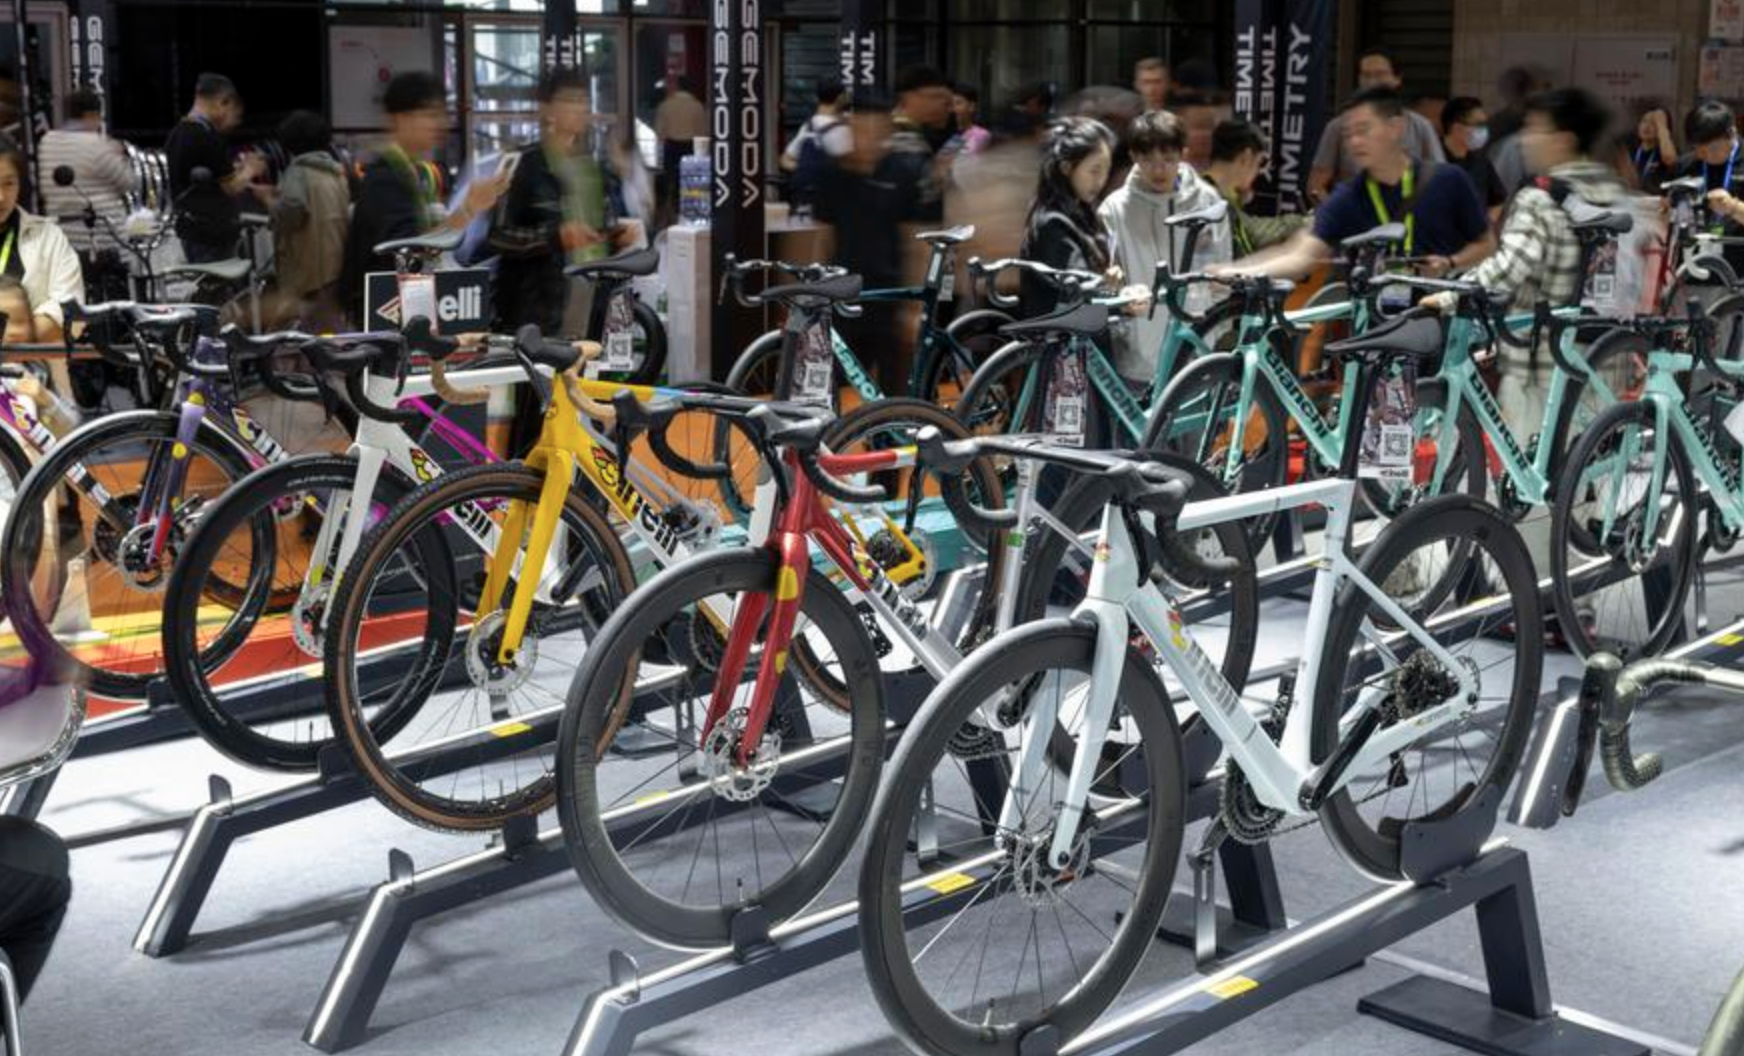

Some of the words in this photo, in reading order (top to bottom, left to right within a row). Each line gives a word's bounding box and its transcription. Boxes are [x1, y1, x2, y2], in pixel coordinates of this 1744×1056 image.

[841, 31, 855, 92] TIM
[439, 285, 482, 321] elli
[1265, 346, 1328, 438] Bianchi
